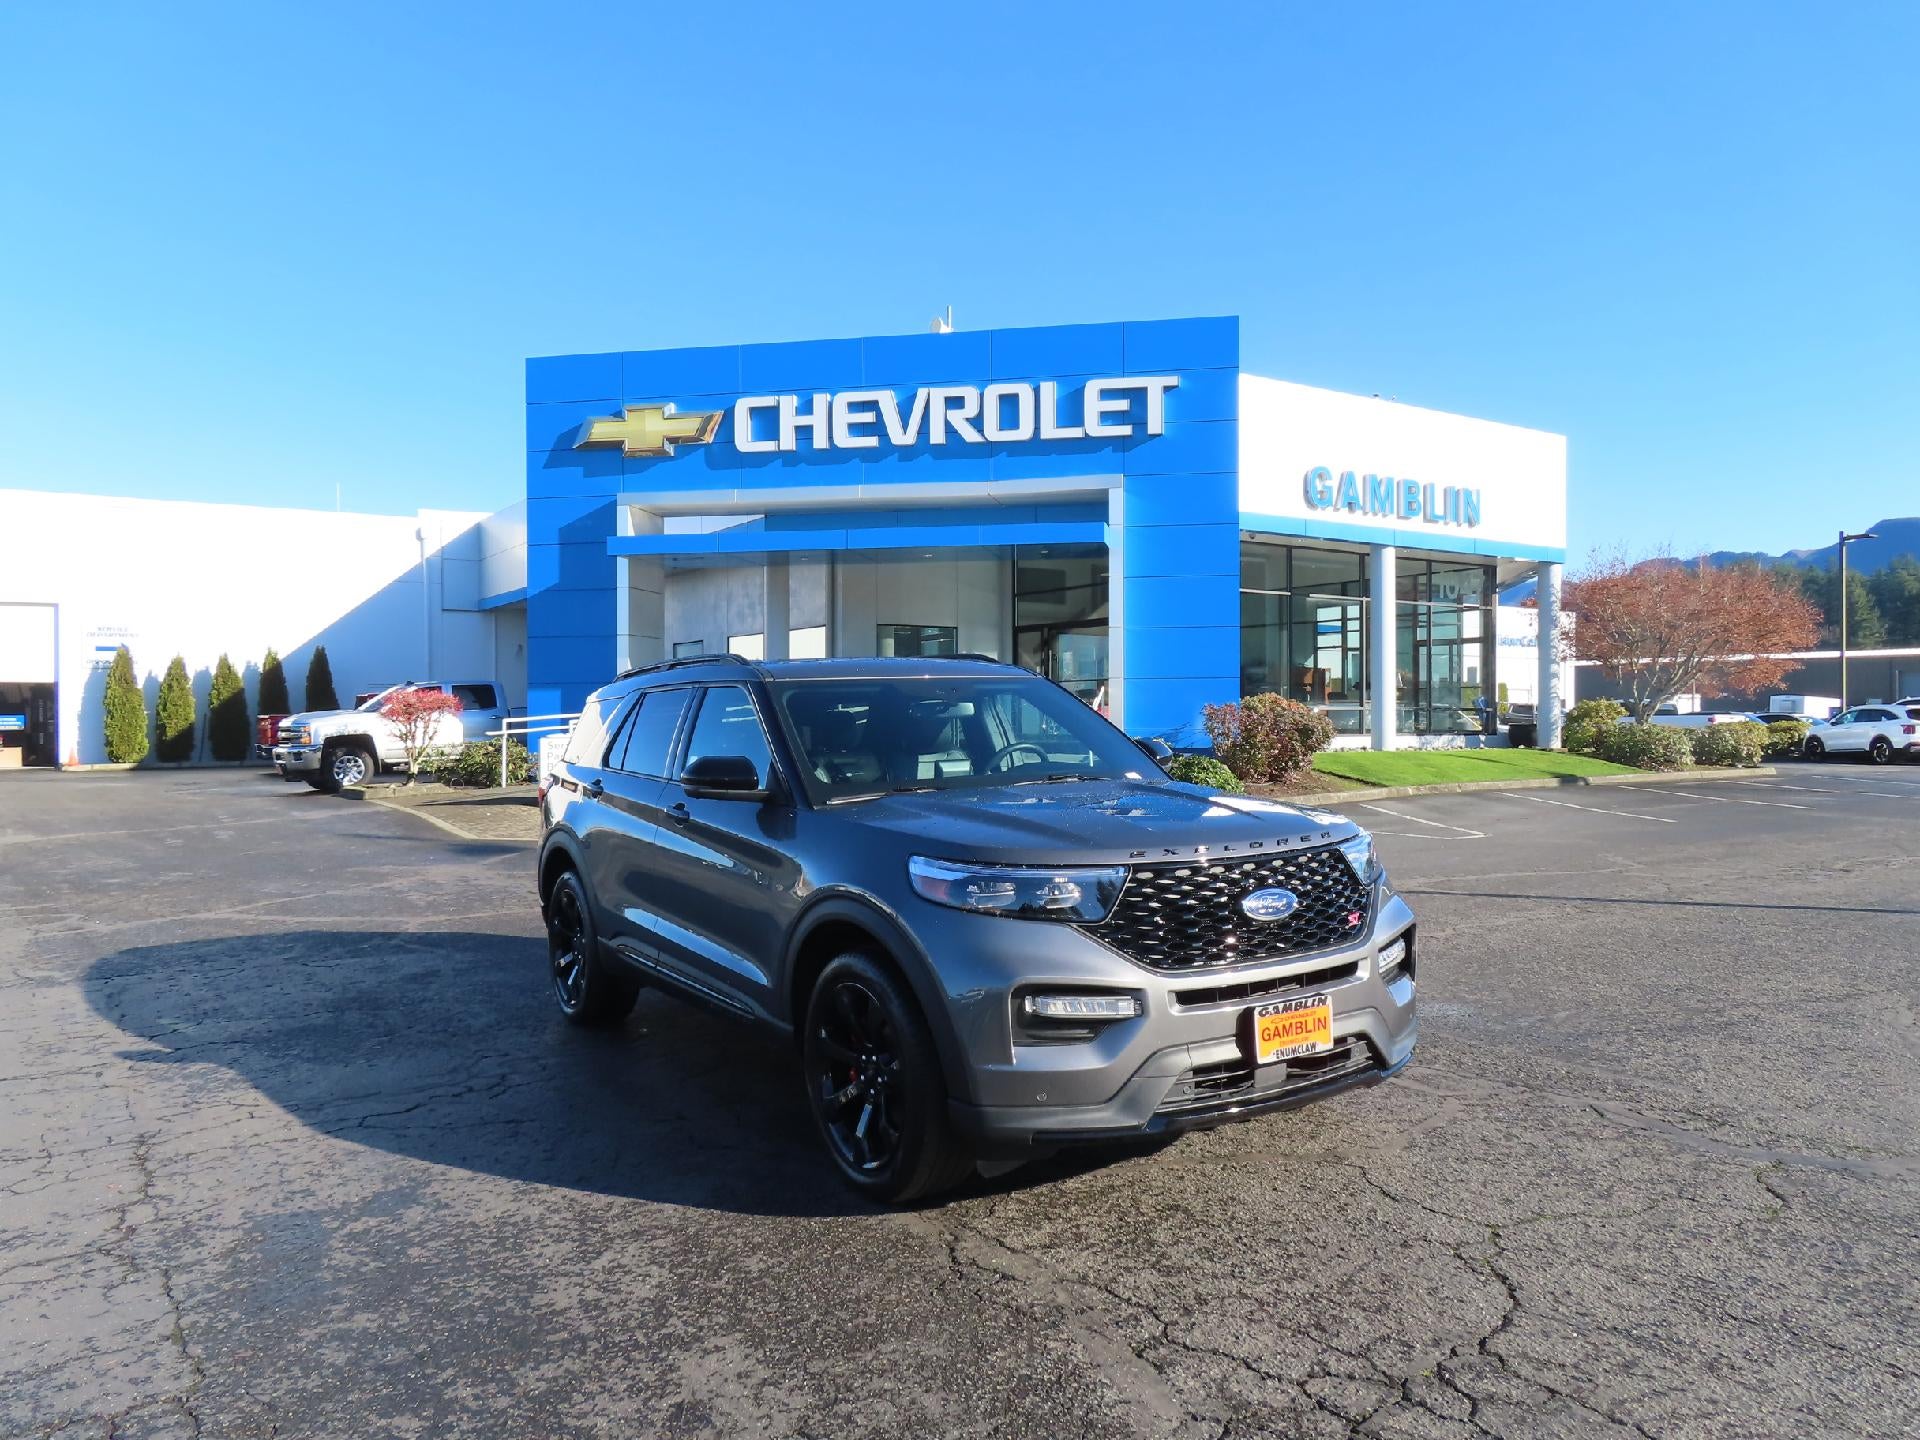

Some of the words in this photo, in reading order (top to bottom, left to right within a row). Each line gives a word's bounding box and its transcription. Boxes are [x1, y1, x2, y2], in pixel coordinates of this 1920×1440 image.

[734, 375, 1179, 453] CHEVROLET
[1303, 466, 1481, 528] GAMBLIN
[1258, 996, 1328, 1018] GAMBLIN
[1261, 1016, 1327, 1042] GAMBLIN
